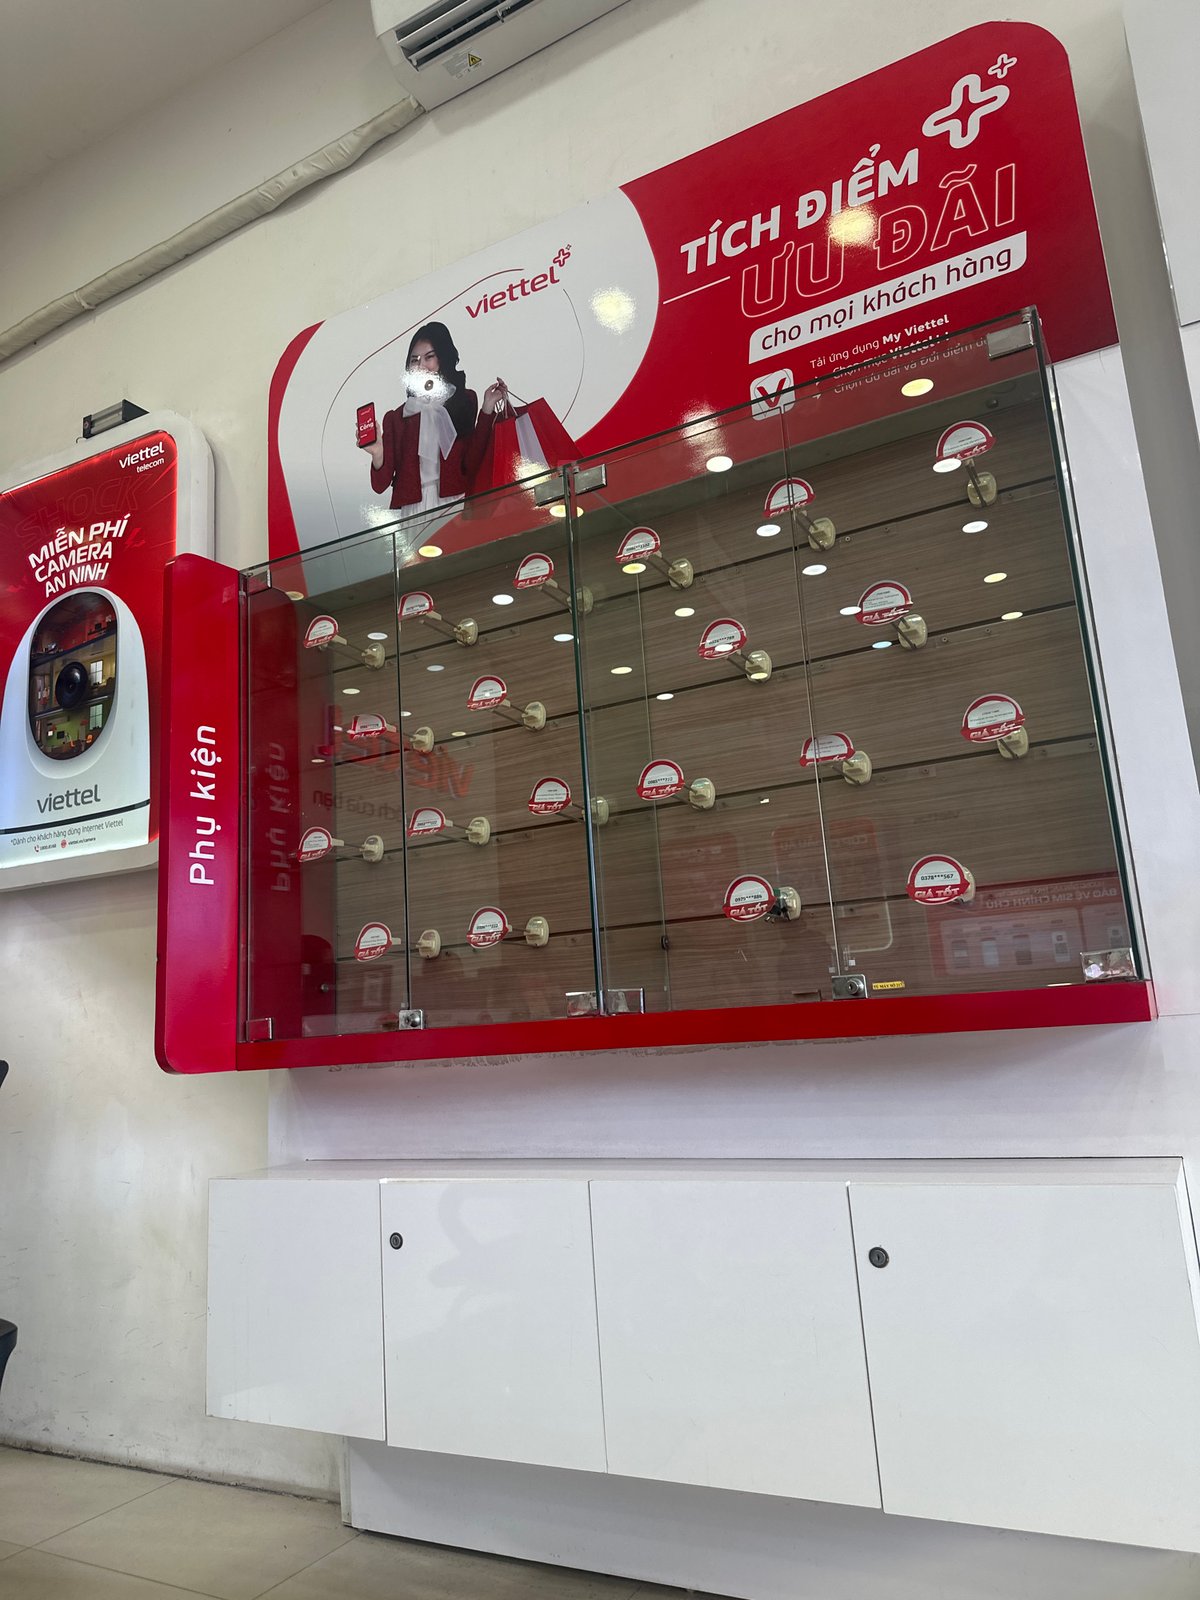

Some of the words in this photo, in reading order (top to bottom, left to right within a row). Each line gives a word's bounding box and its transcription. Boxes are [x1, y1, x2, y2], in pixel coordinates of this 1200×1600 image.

[680, 205, 781, 274] TÍCH
[795, 143, 919, 230] ĐIỂM
[741, 236, 845, 318] ƯU
[873, 163, 1016, 272] ĐÃI
[761, 324, 802, 351] cho
[810, 301, 854, 334] mọi
[863, 273, 937, 314] khách
[946, 246, 1012, 286] hàng
[810, 356, 826, 369] Tải
[829, 350, 849, 363] ứng
[852, 340, 880, 356] dụng
[882, 332, 901, 345] My
[904, 314, 950, 337] Viettel
[119, 442, 165, 469] viettel
[136, 457, 165, 473] telecom
[28, 526, 84, 568] MIỄN
[89, 513, 131, 541] PHÍ
[35, 541, 112, 583] CAMERA
[45, 573, 66, 598] AN
[69, 562, 109, 586] NINH
[970, 727, 990, 739] GIÁ
[189, 725, 222, 801] kiện
[37, 784, 101, 814] viettel
[105, 818, 124, 829] Viettel
[189, 815, 222, 886] Phụ
[730, 906, 747, 916] GIÁ
[748, 902, 768, 914] TỐT
[914, 888, 934, 898] GIÁ
[936, 885, 960, 897] TỐT
